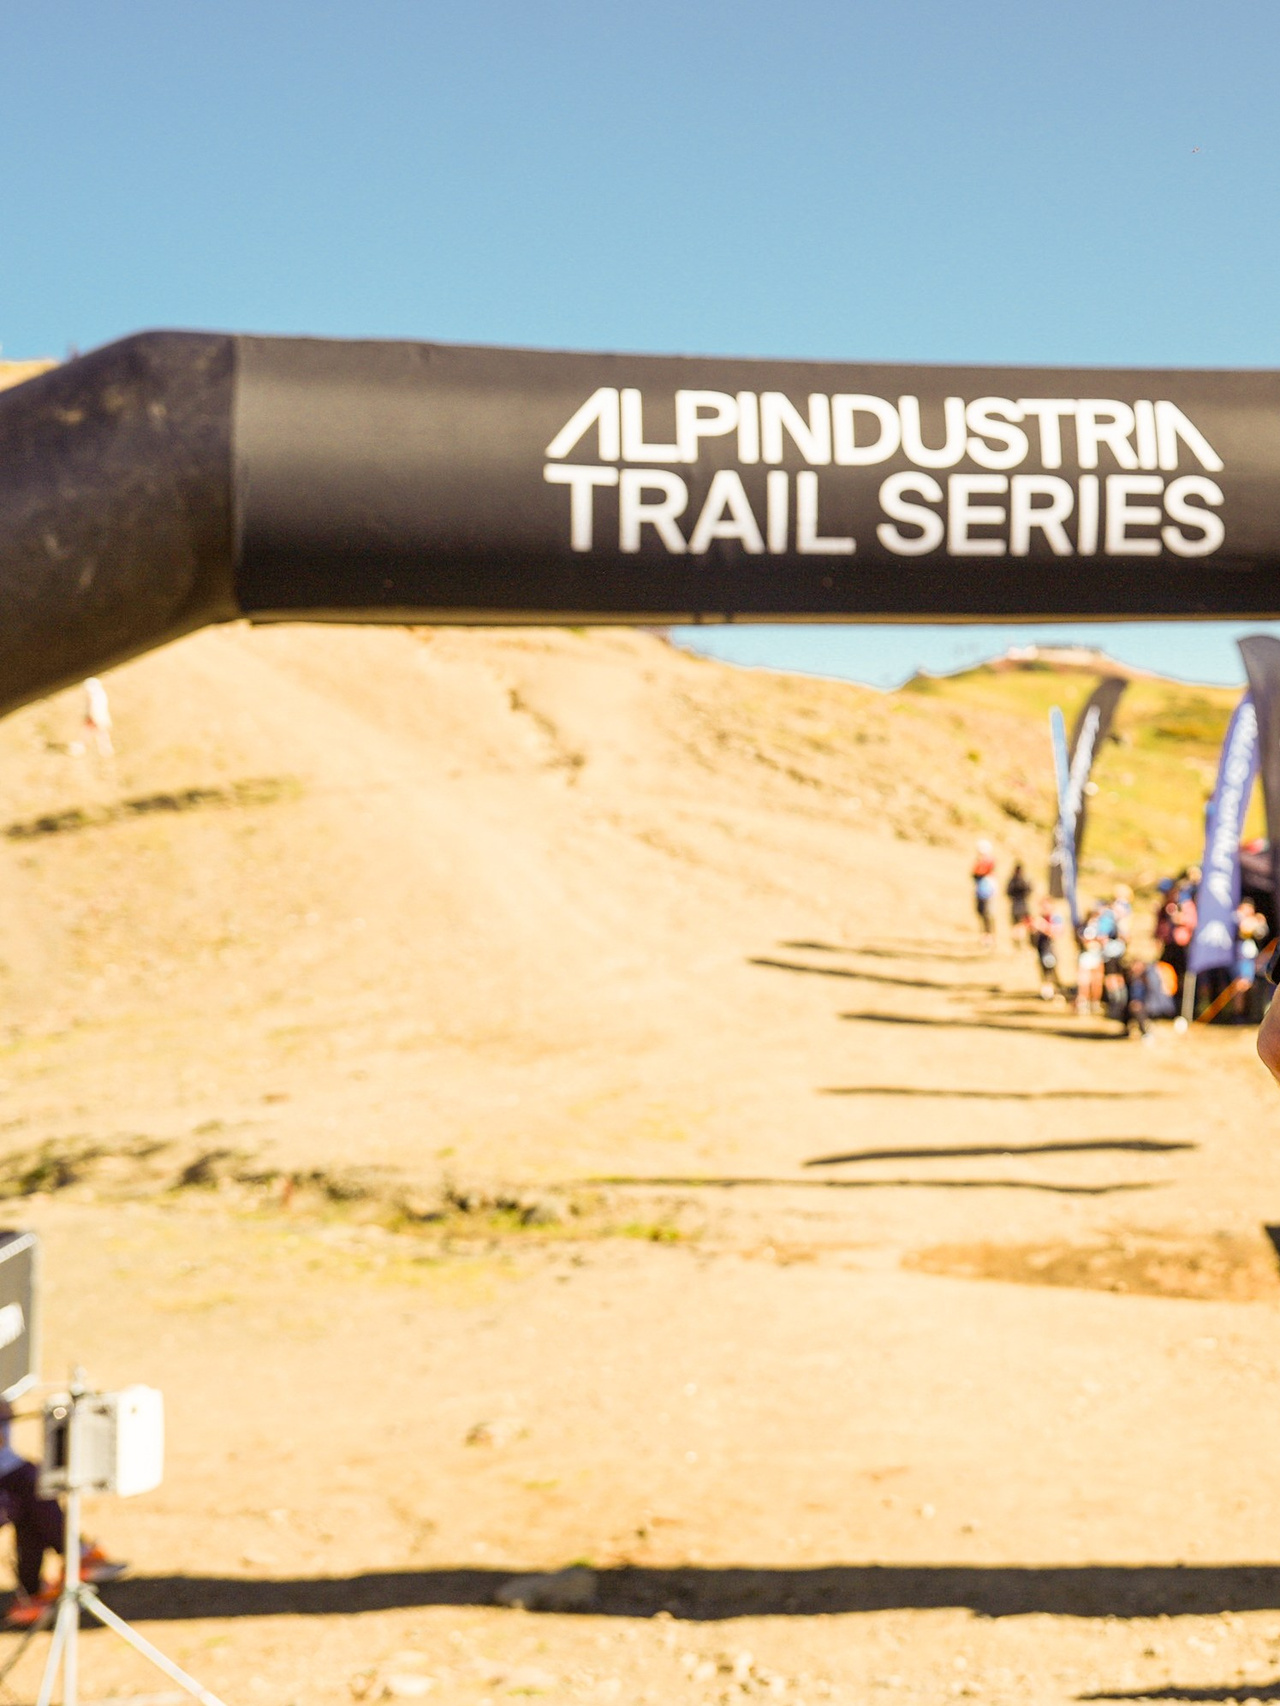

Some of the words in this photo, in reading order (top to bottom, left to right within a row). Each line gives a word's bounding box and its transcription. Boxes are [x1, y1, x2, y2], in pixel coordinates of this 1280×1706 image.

[546, 387, 1225, 472] ALPINDUSTRIA
[543, 463, 857, 554] TRAIL
[876, 471, 1226, 558] SERIES
